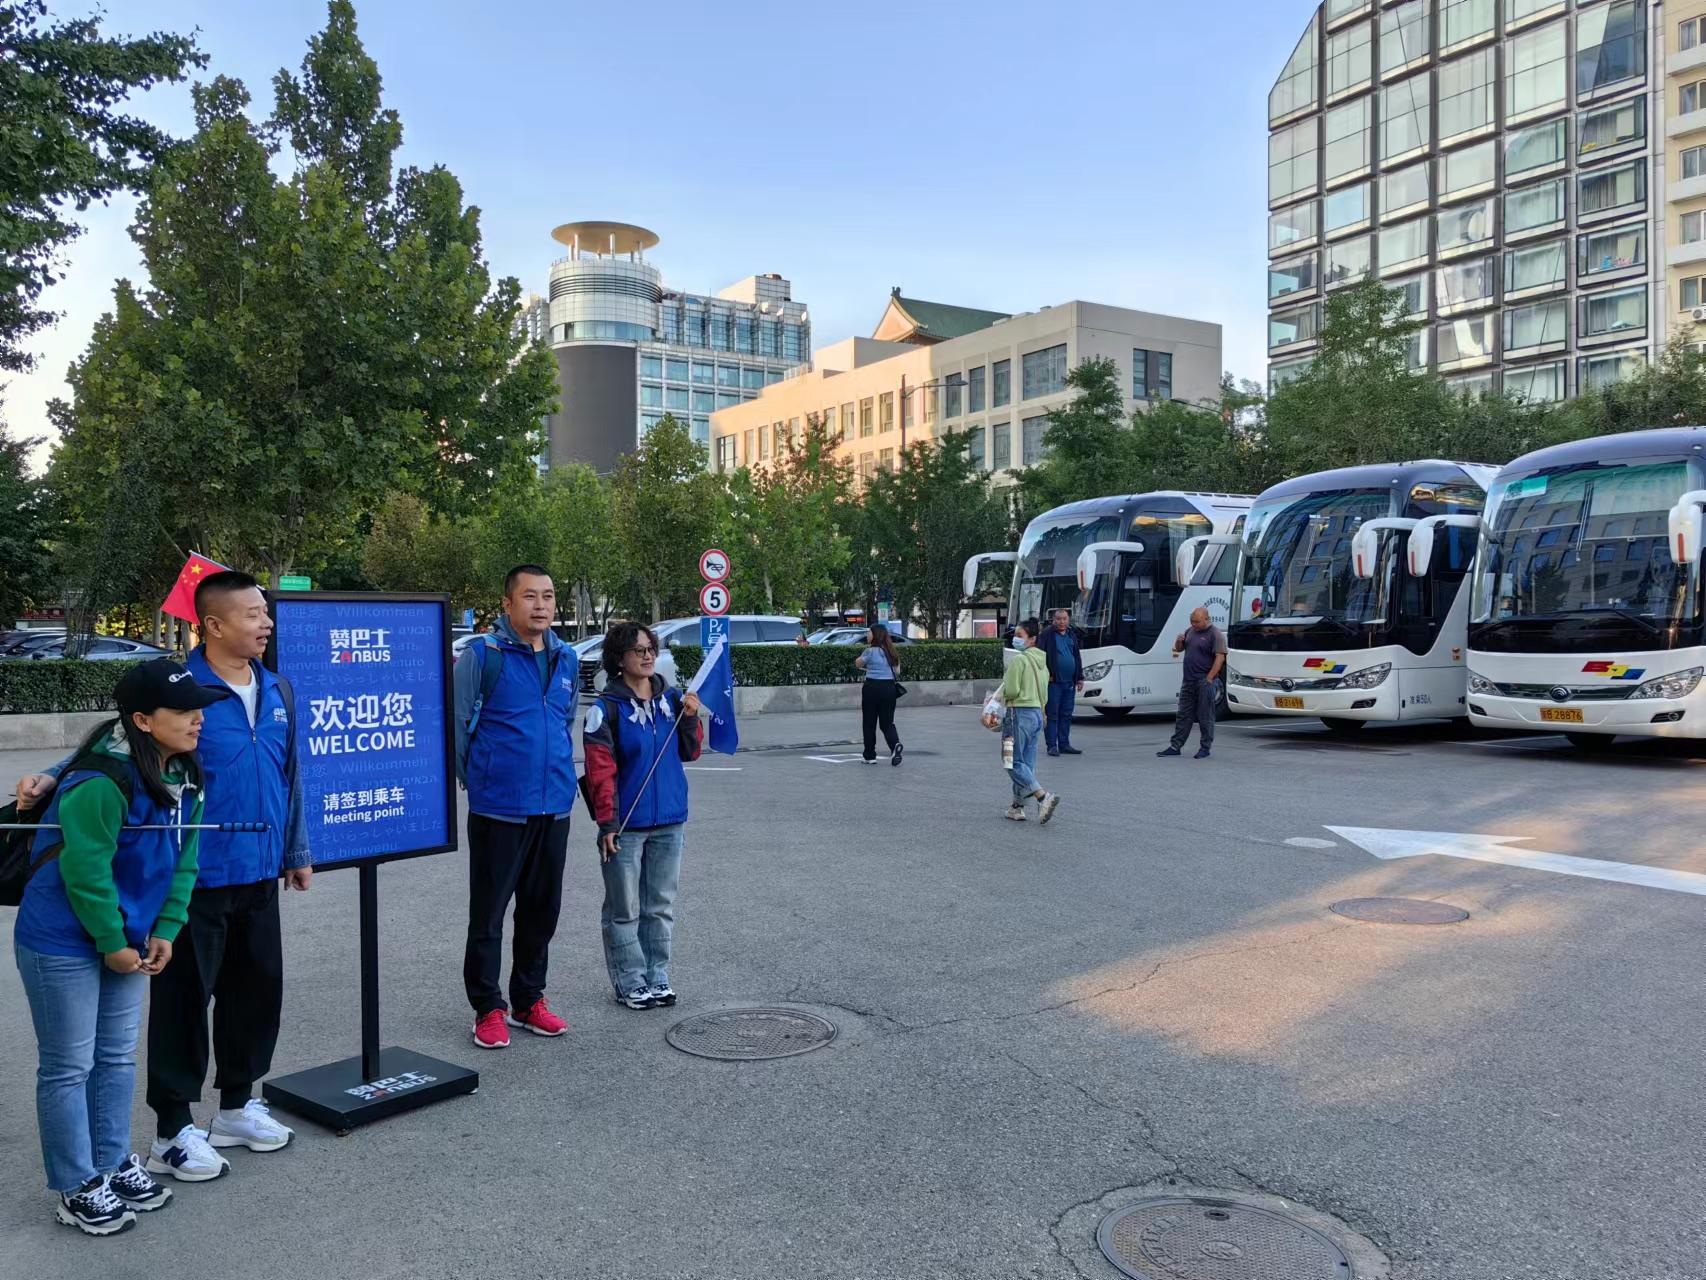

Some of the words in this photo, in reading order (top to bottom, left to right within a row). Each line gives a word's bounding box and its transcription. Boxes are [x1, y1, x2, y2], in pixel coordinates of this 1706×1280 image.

[710, 591, 720, 608] 5
[709, 619, 719, 632] P
[330, 628, 390, 648] 赞巴士
[331, 650, 390, 663] ZANBUS
[310, 693, 413, 731] 欢迎您
[308, 730, 415, 755] WELCOME
[323, 786, 405, 811] 请签到乘车
[323, 808, 371, 825] Meeting
[374, 805, 404, 820] point
